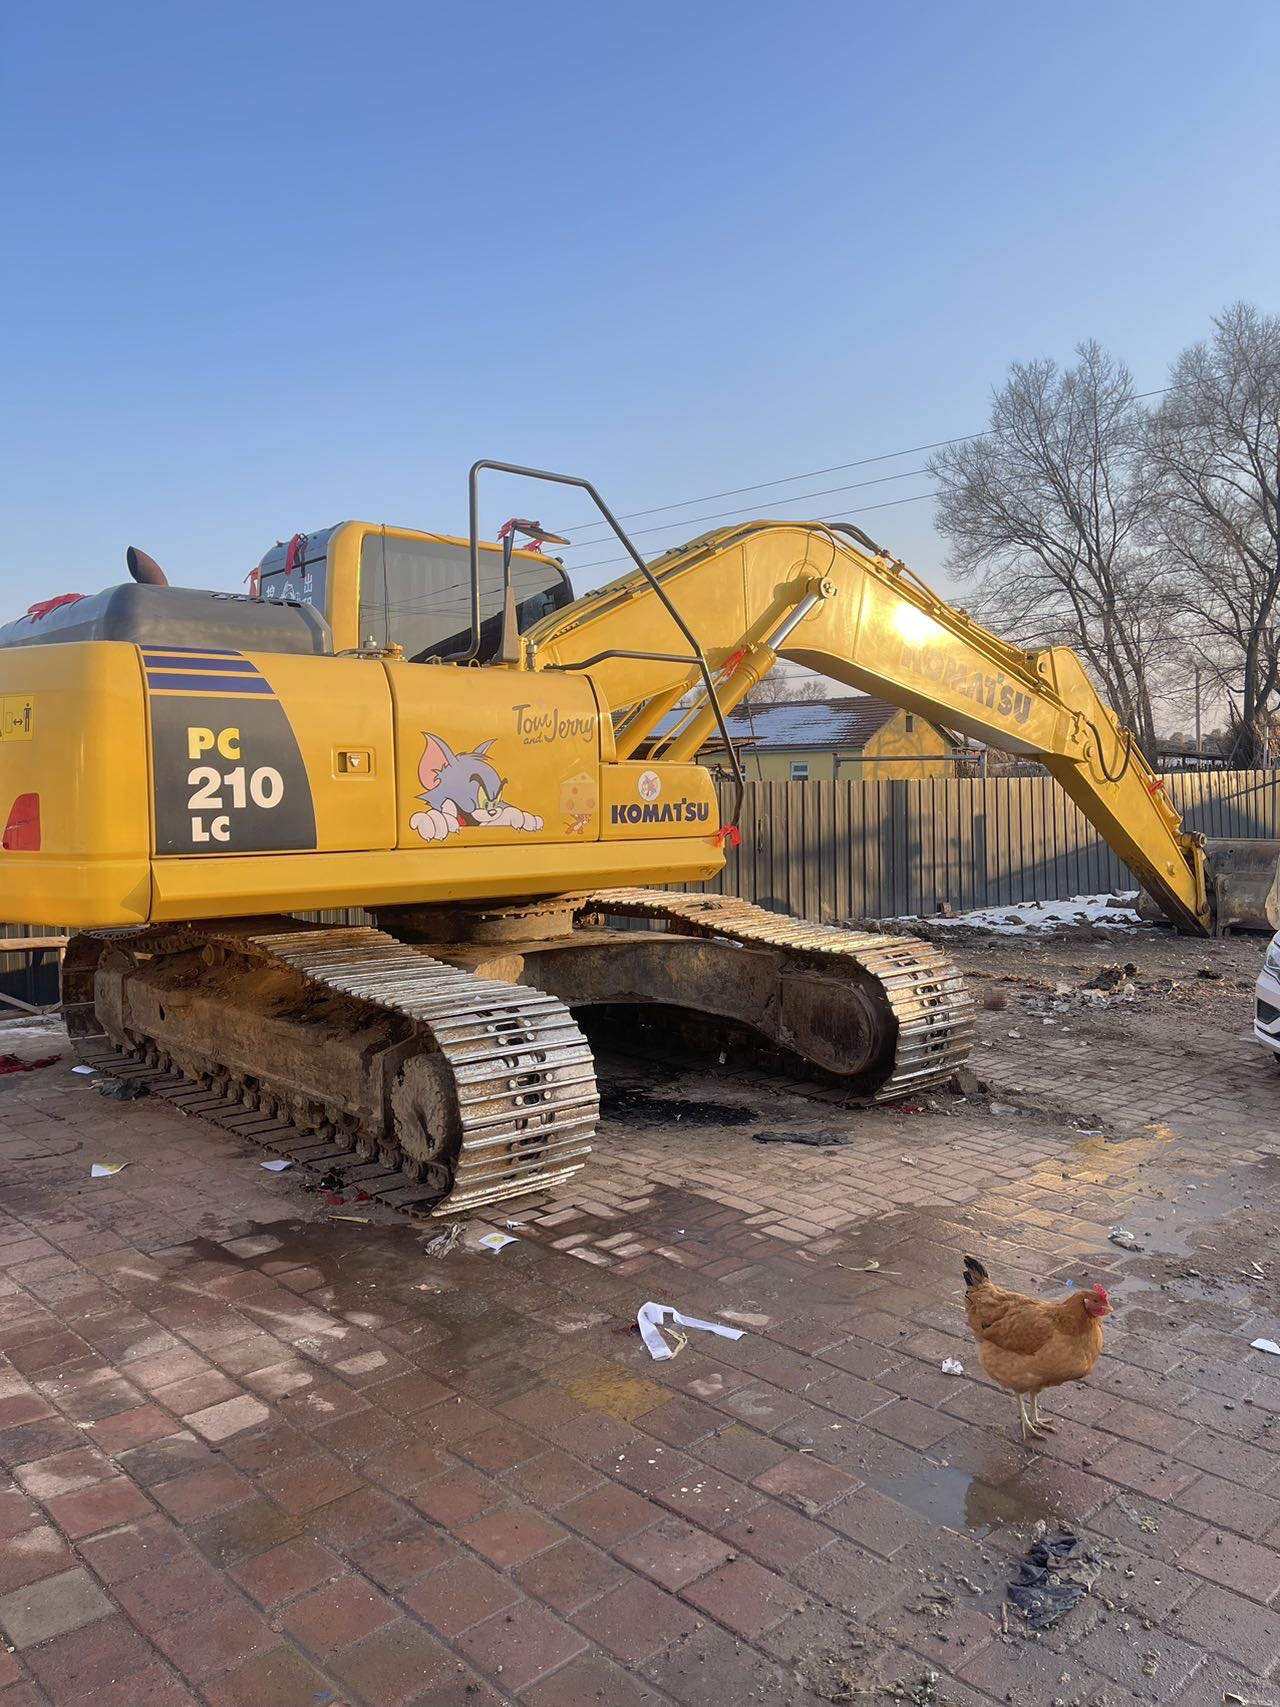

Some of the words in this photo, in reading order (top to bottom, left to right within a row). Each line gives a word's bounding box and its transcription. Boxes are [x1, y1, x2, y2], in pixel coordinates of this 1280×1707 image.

[512, 704, 552, 735] Tom
[544, 708, 594, 743] Jerry
[187, 727, 241, 760] PC
[523, 732, 543, 745] and
[187, 766, 284, 809] 210
[611, 798, 709, 824] KOMATSU
[191, 815, 231, 842] LC
